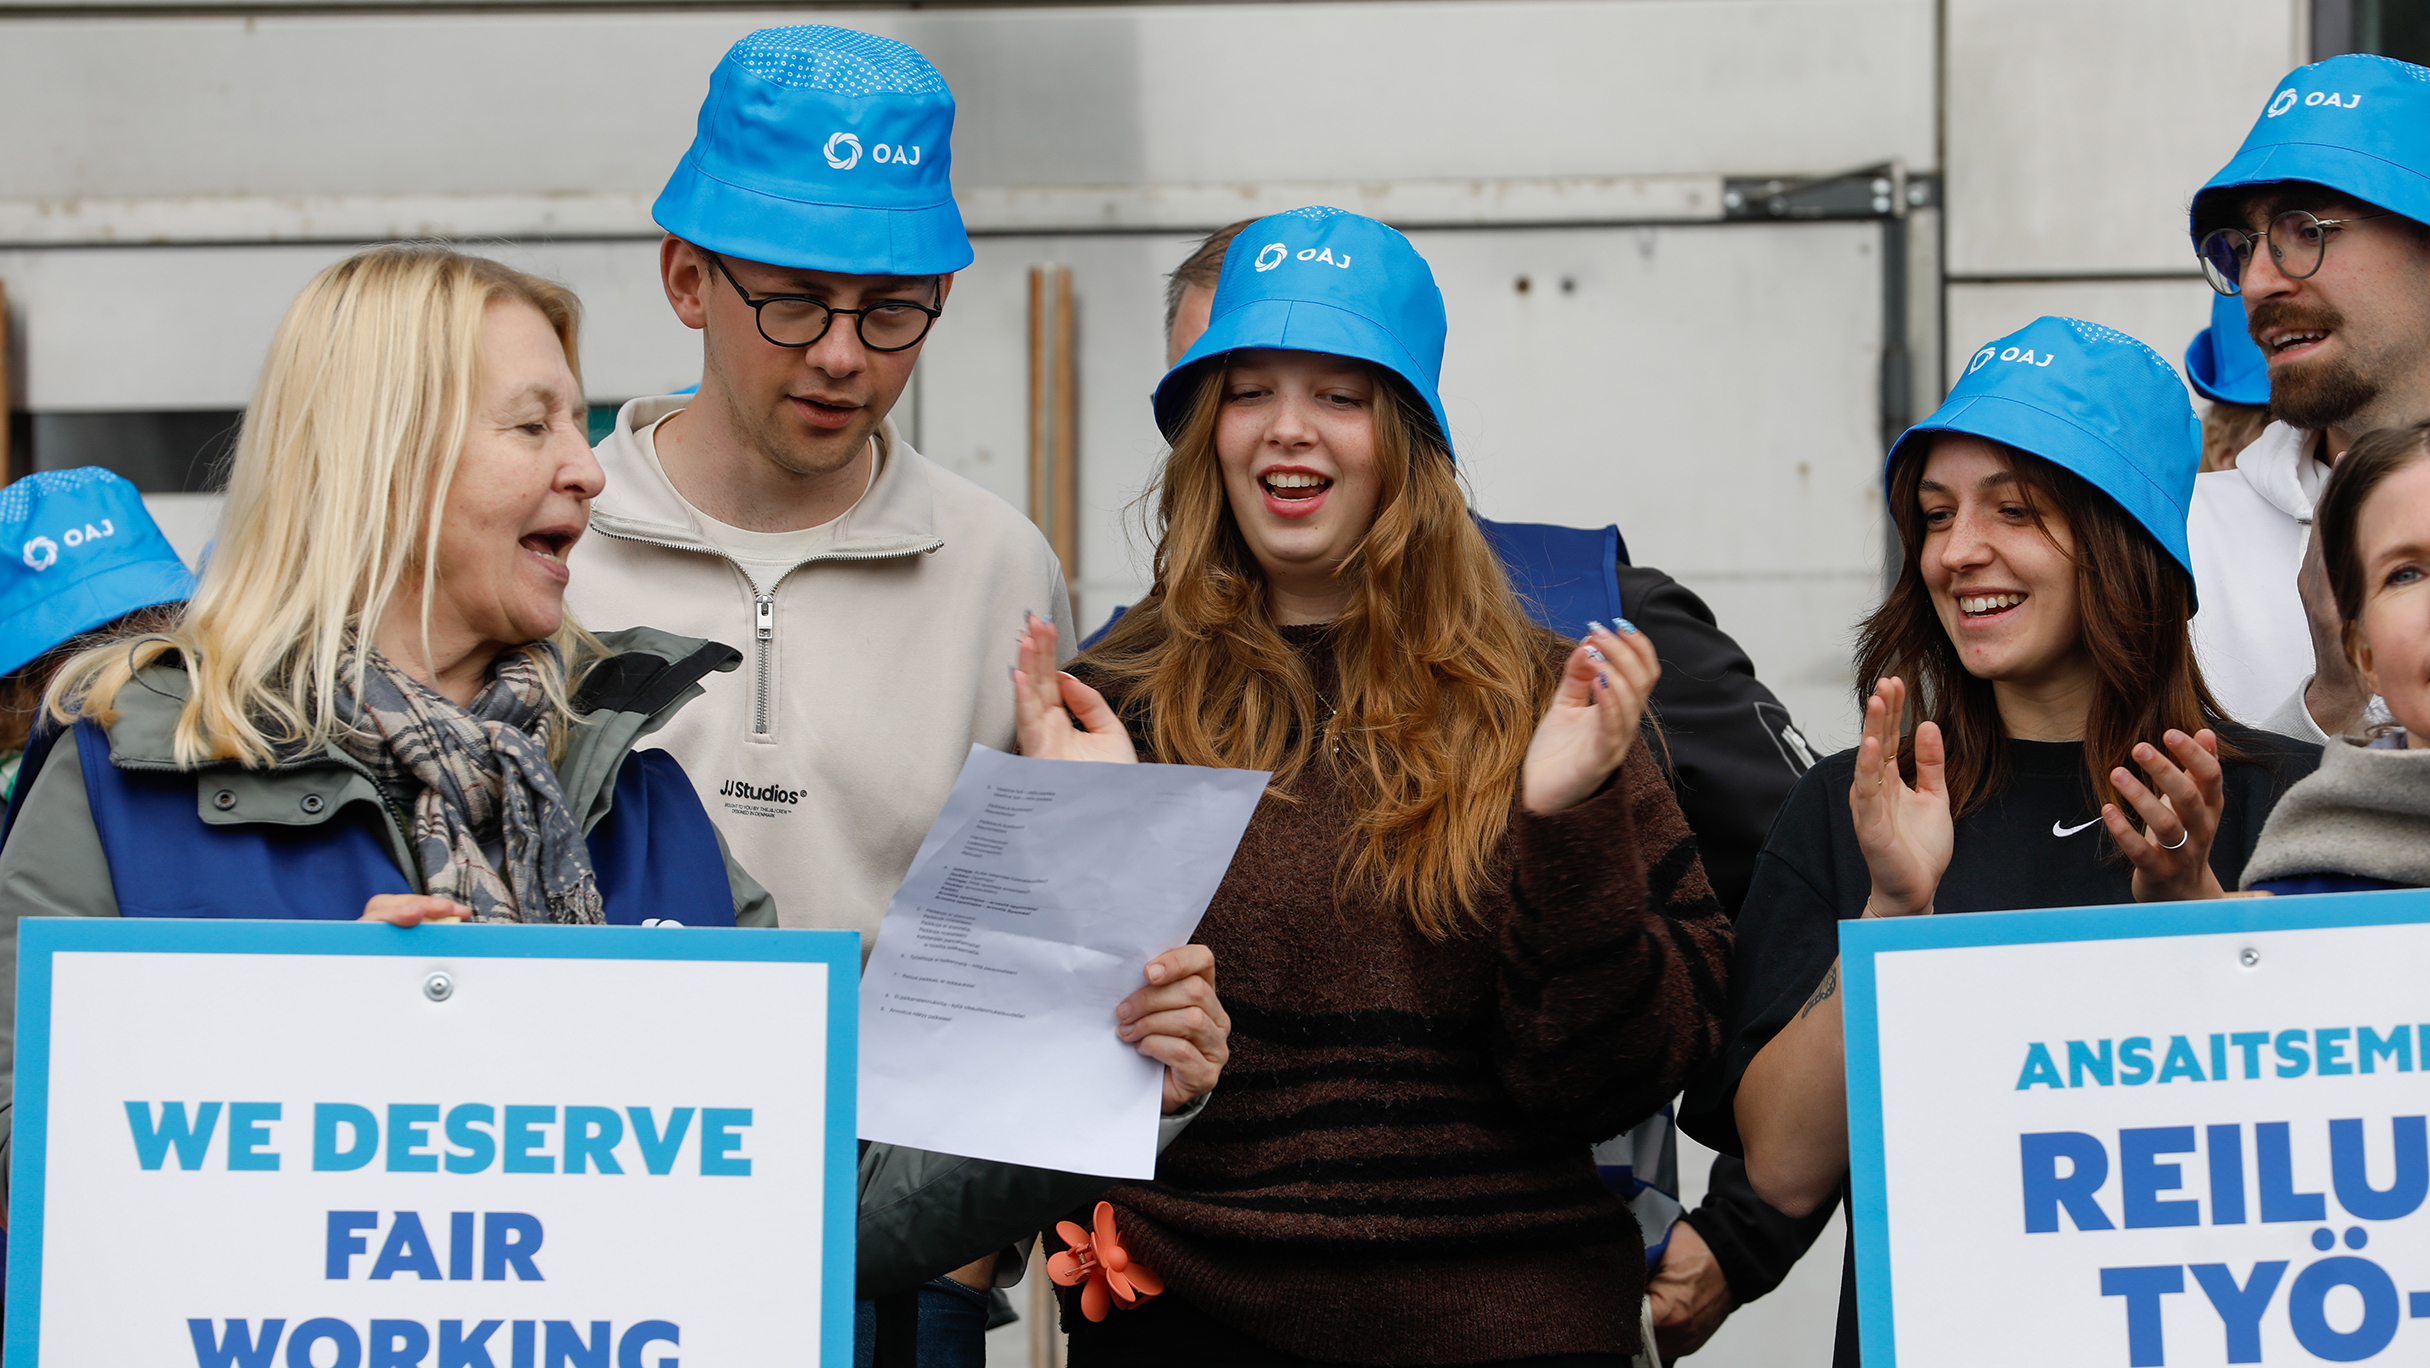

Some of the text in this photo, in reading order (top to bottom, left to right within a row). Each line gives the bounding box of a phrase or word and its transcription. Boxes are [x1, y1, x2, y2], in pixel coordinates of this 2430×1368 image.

[2304, 91, 2362, 109] OAJ
[872, 143, 921, 165] OAJ
[1296, 247, 1352, 269] OAJ
[1999, 346, 2055, 367] OAJ
[63, 518, 115, 547] OAJ
[2015, 1024, 2430, 1091] ANSAITSEM
[124, 1101, 753, 1177] WE DESERVE
[2020, 1116, 2430, 1234] REILU
[325, 1210, 545, 1282] FAIR
[187, 1317, 680, 1368] WORKING
